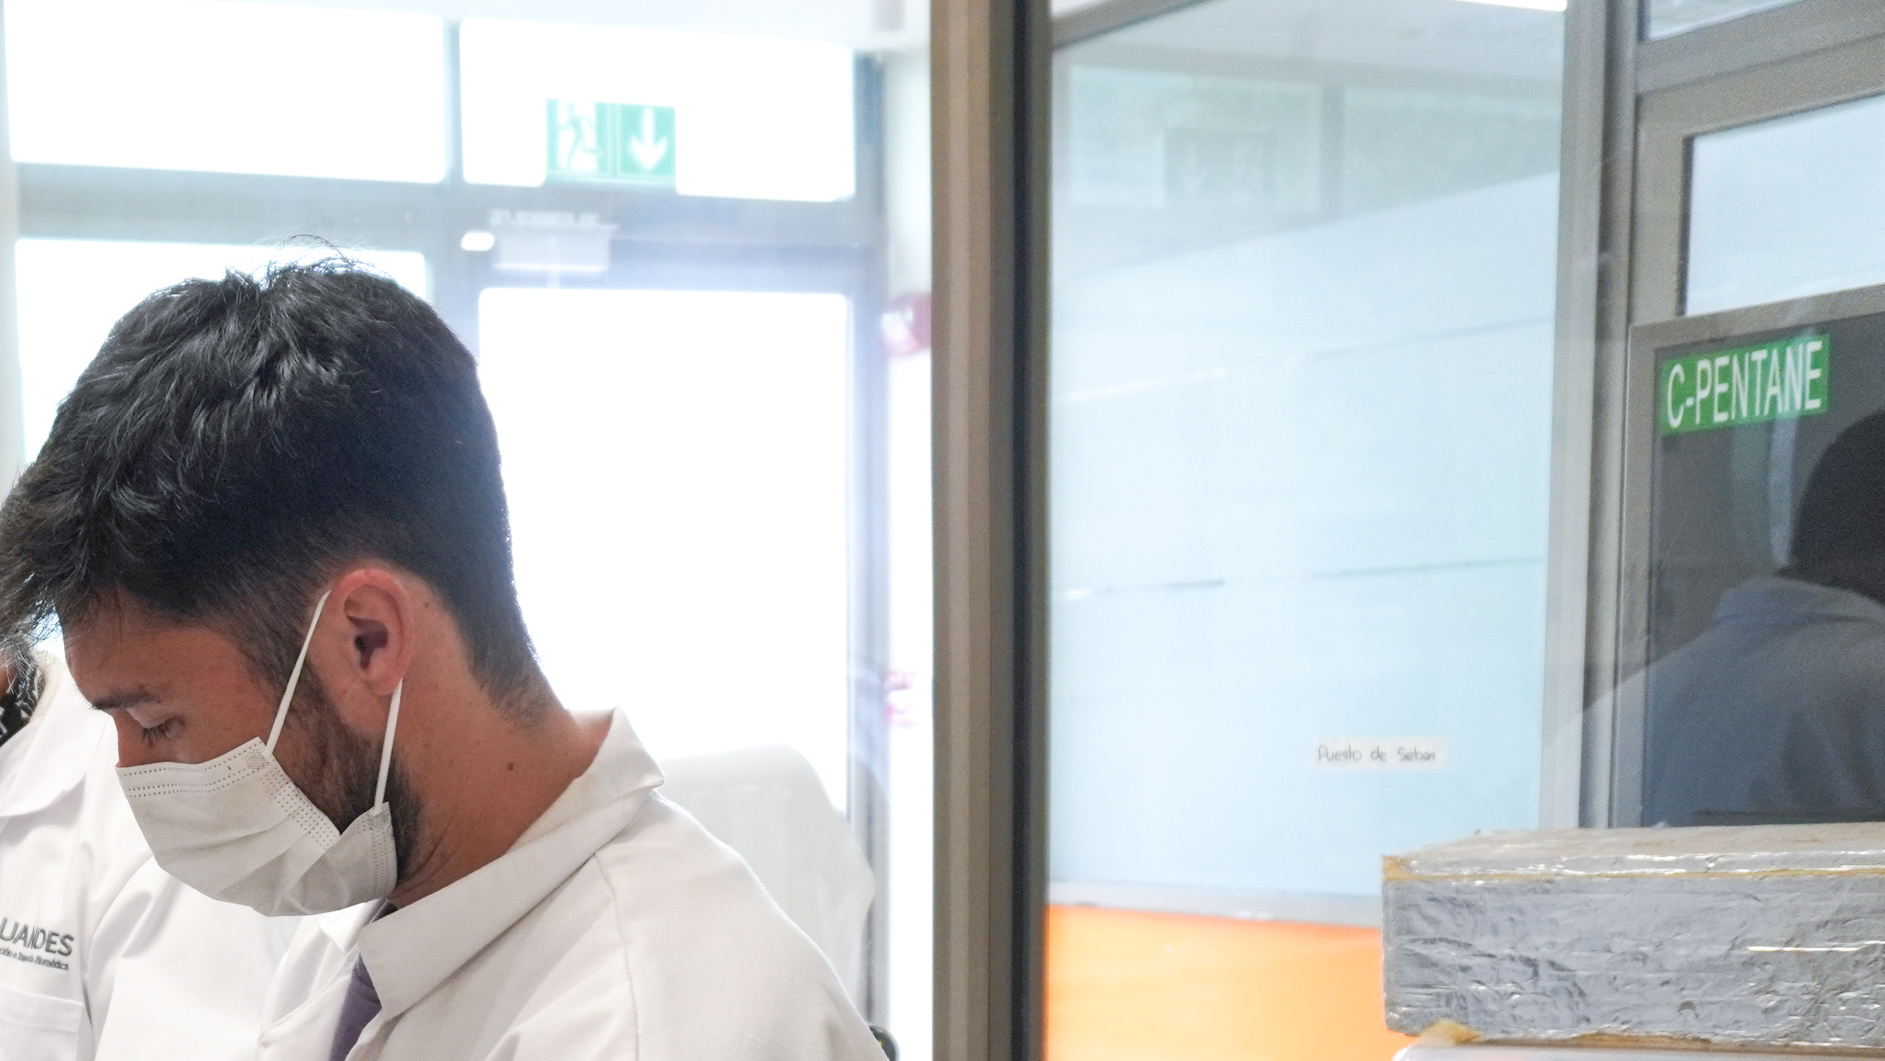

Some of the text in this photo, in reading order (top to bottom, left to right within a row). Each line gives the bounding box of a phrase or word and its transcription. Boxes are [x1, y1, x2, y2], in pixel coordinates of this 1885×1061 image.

[1667, 340, 1823, 428] C-PENTANE
[1318, 744, 1362, 761] Puesto
[1370, 745, 1387, 761] de
